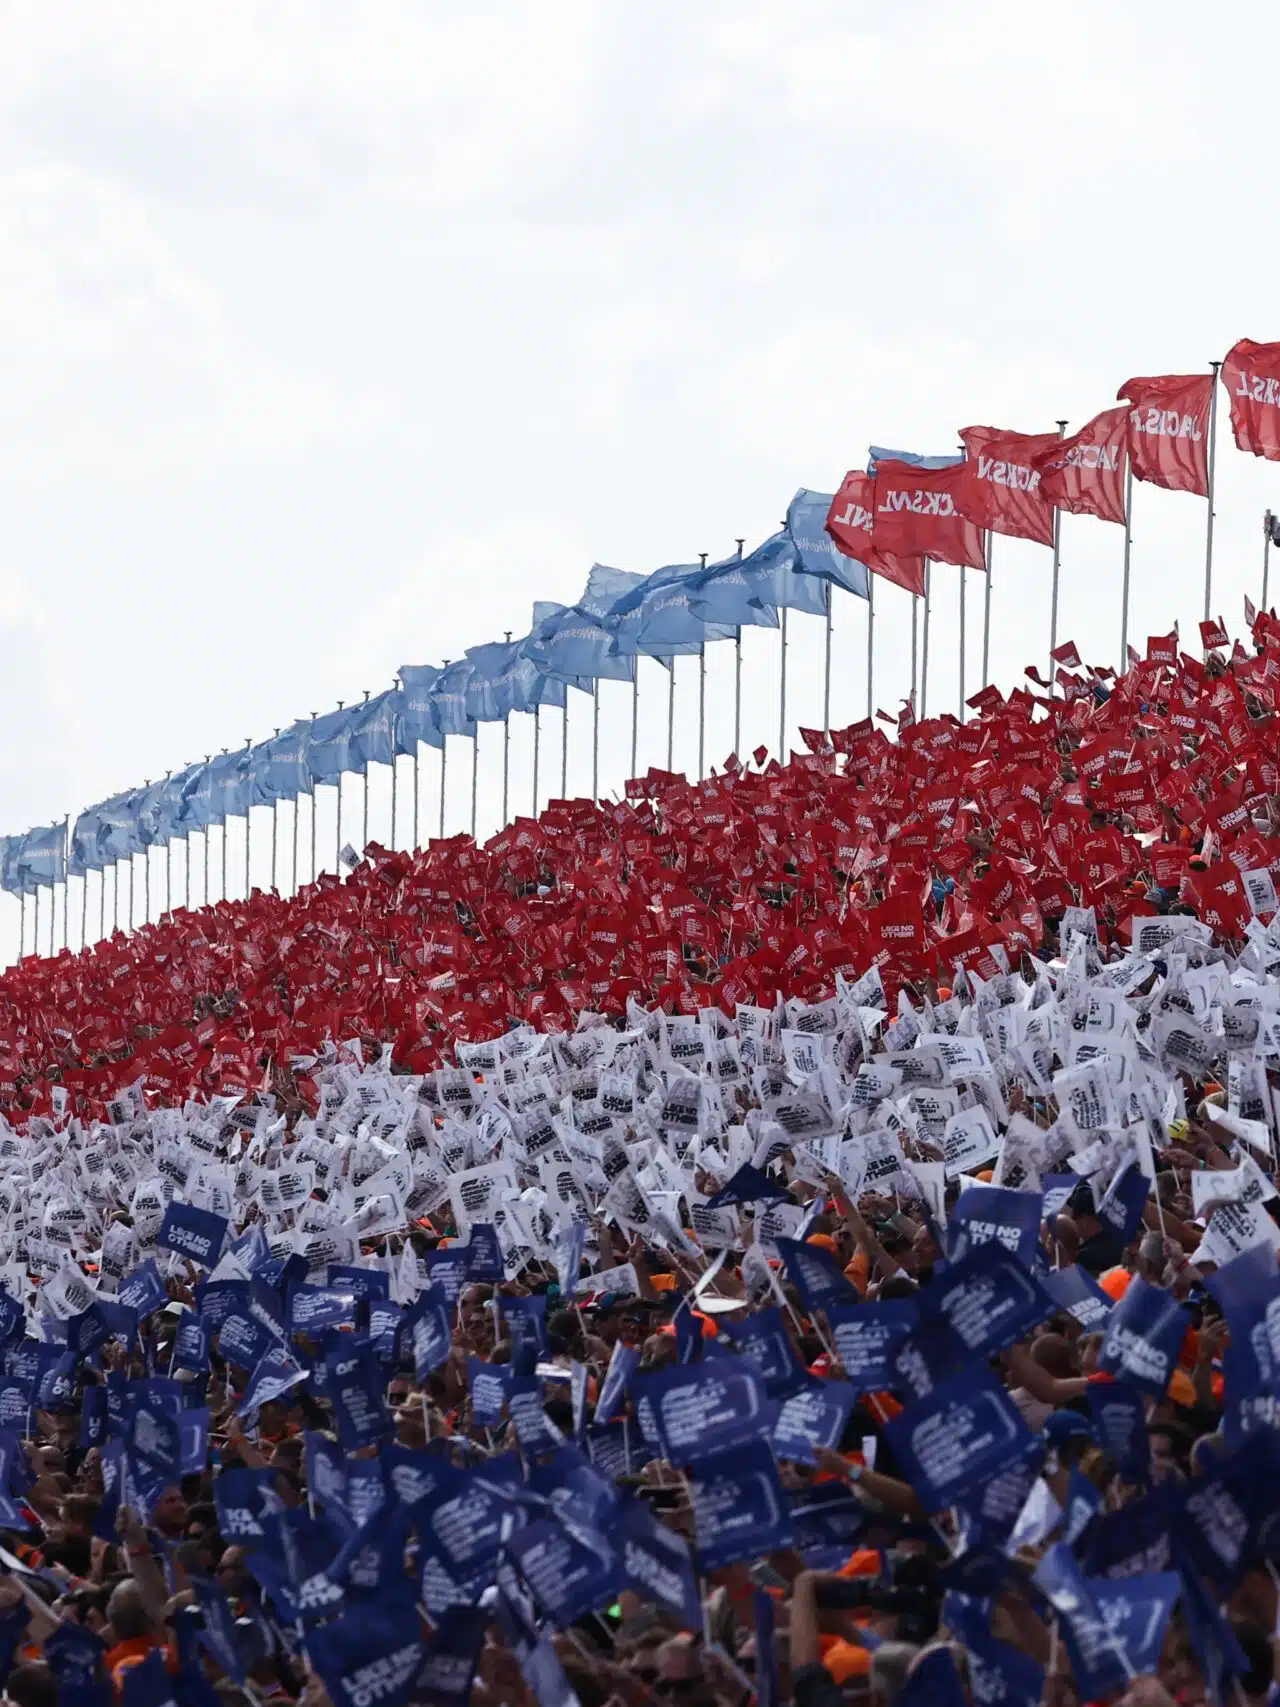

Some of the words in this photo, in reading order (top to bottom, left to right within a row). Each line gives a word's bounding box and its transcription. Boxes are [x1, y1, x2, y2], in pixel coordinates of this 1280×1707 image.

[671, 1043, 689, 1051] LIKE
[690, 1042, 704, 1050] NO
[169, 1224, 194, 1242] LIKE
[193, 1234, 212, 1249] NO
